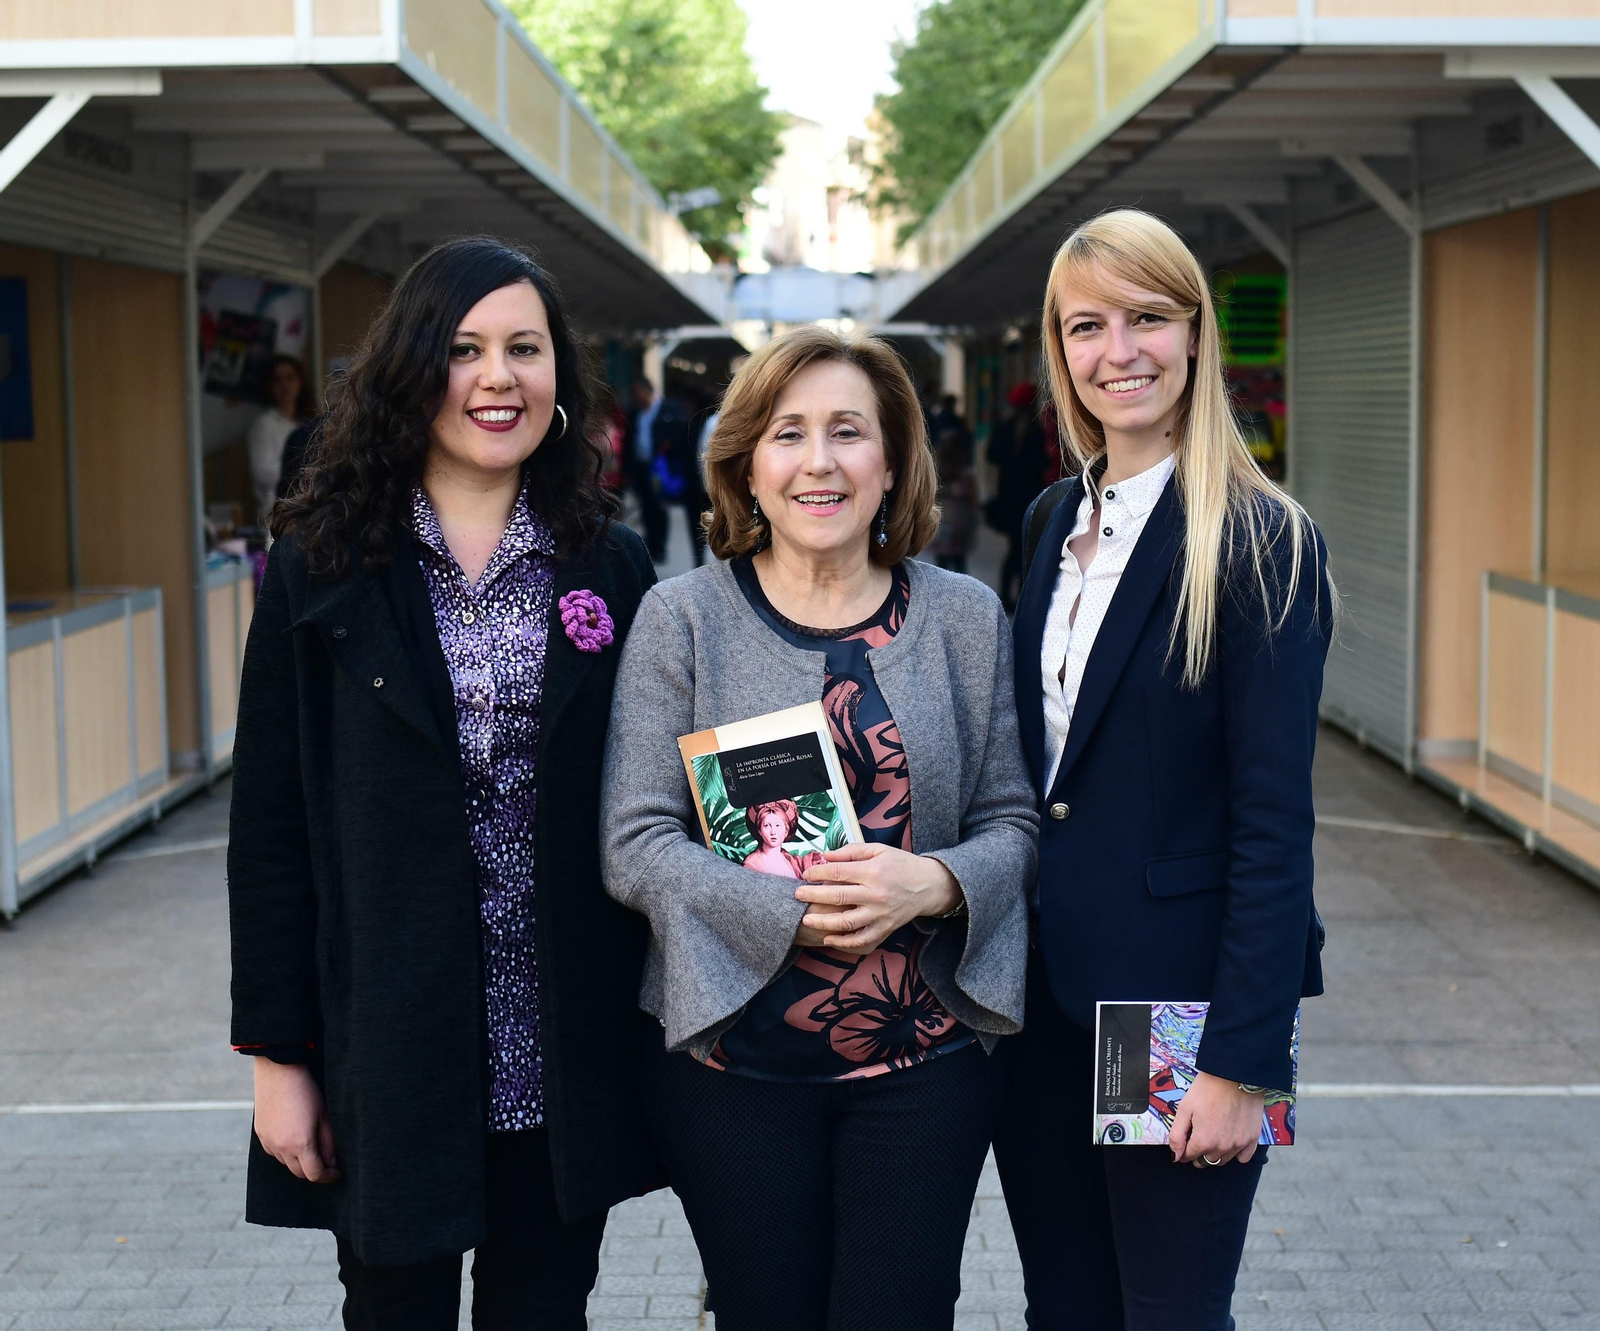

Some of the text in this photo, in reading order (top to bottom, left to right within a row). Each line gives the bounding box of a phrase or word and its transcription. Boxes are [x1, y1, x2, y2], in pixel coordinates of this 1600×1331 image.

[743, 757, 769, 766] IMPRONTA
[770, 752, 791, 760] CLÁSICA
[778, 757, 795, 765] MARÍA
